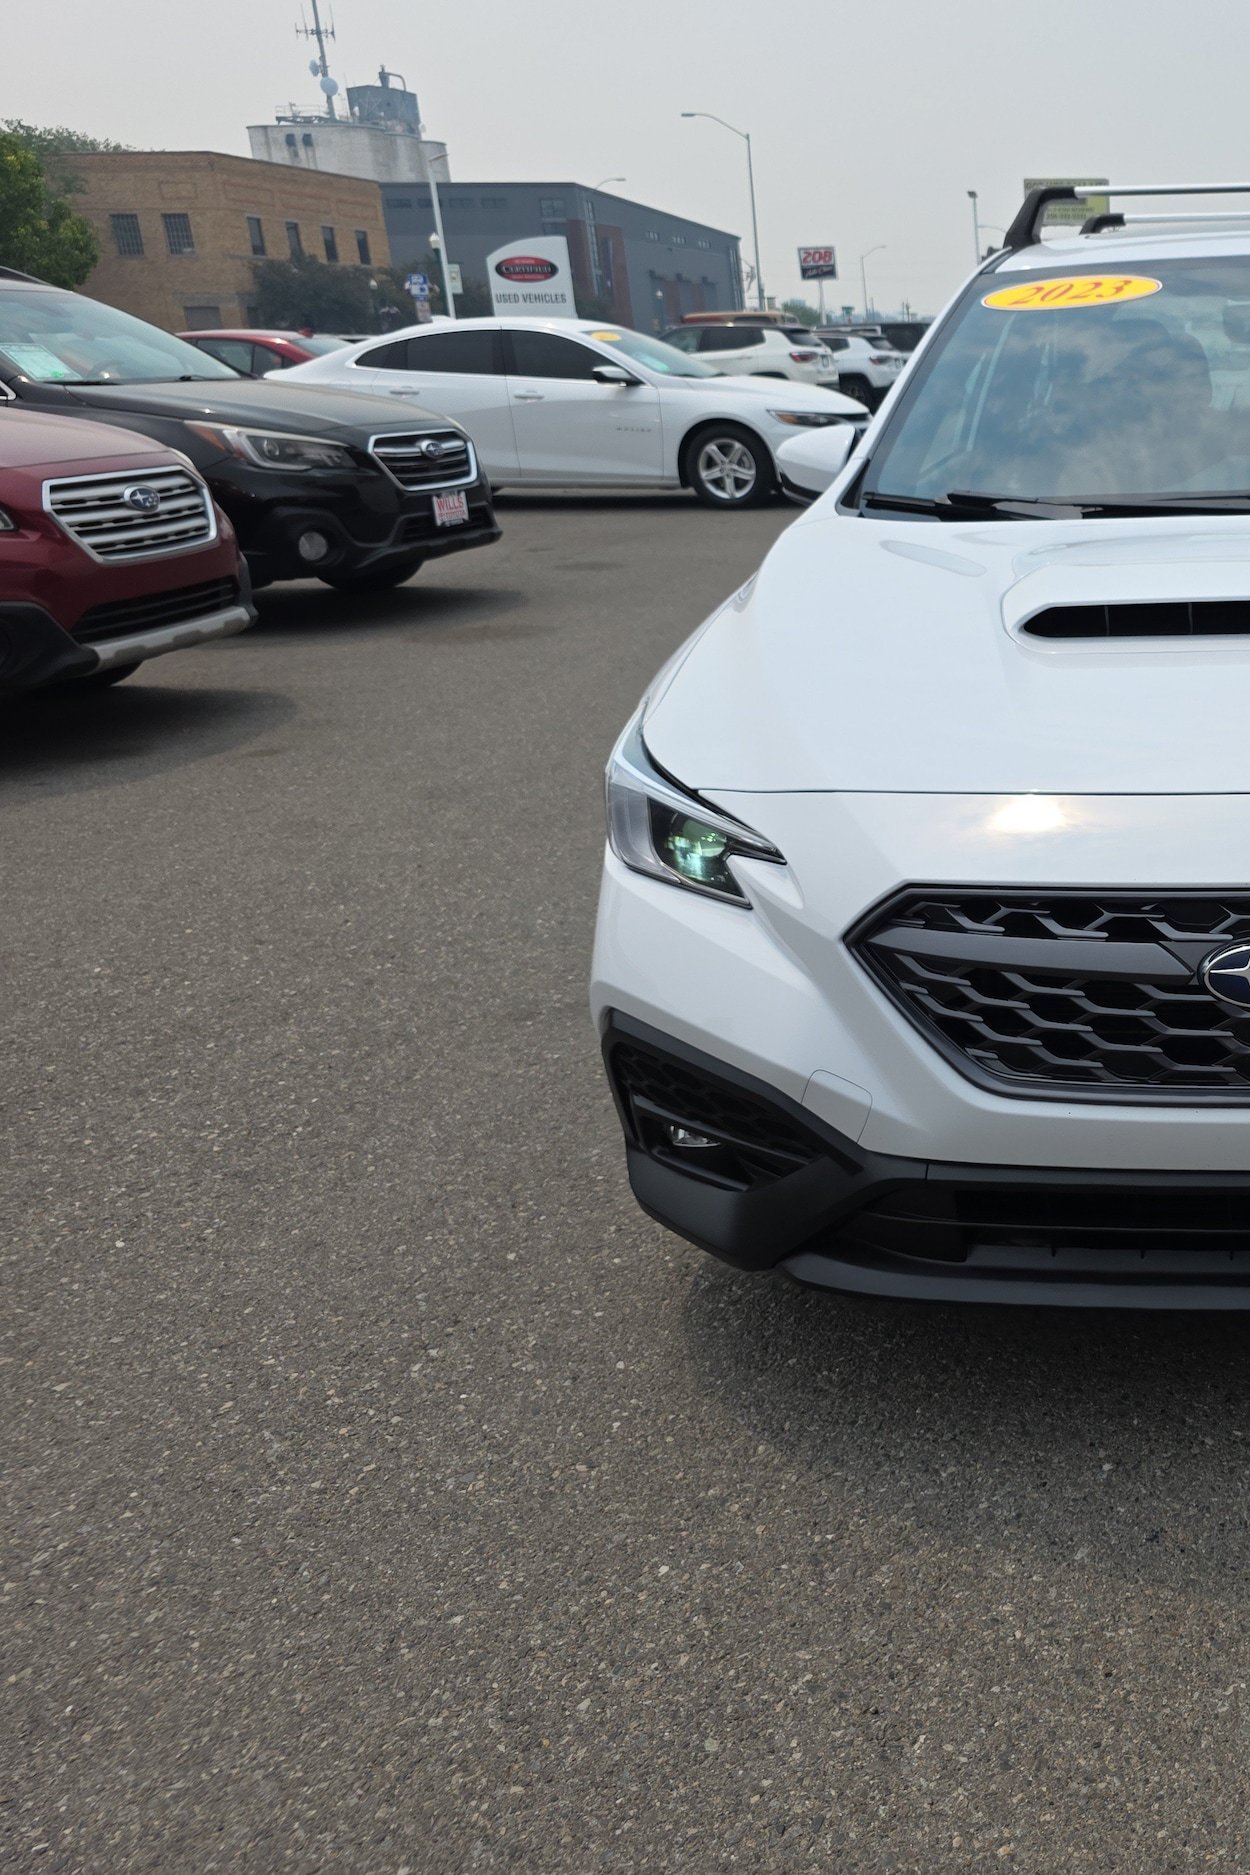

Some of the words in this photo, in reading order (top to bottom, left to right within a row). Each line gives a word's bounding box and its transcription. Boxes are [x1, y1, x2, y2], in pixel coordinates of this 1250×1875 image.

[802, 250, 833, 265] 208
[496, 293, 520, 304] USED
[522, 292, 567, 304] VEHICLES
[1007, 279, 1132, 305] 2023
[436, 495, 464, 511] WILLS
